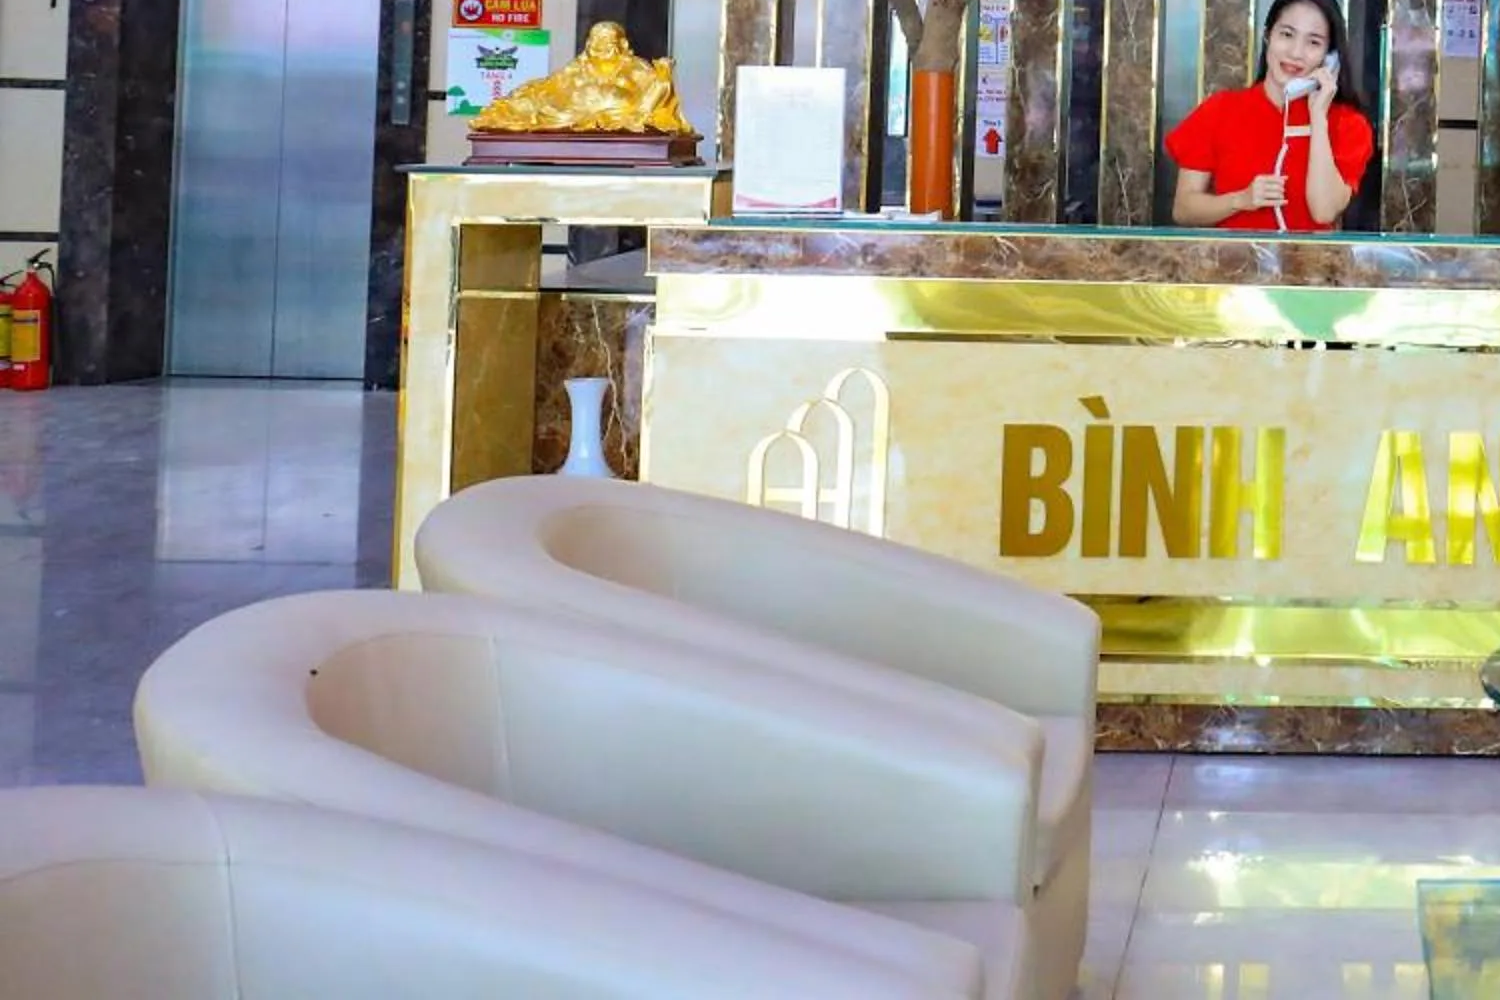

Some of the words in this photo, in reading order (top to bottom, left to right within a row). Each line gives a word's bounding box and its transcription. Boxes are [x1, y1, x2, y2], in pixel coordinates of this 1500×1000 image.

[492, 13, 506, 22] NO
[508, 13, 530, 23] FIRE
[999, 396, 1286, 560] BÌNH
